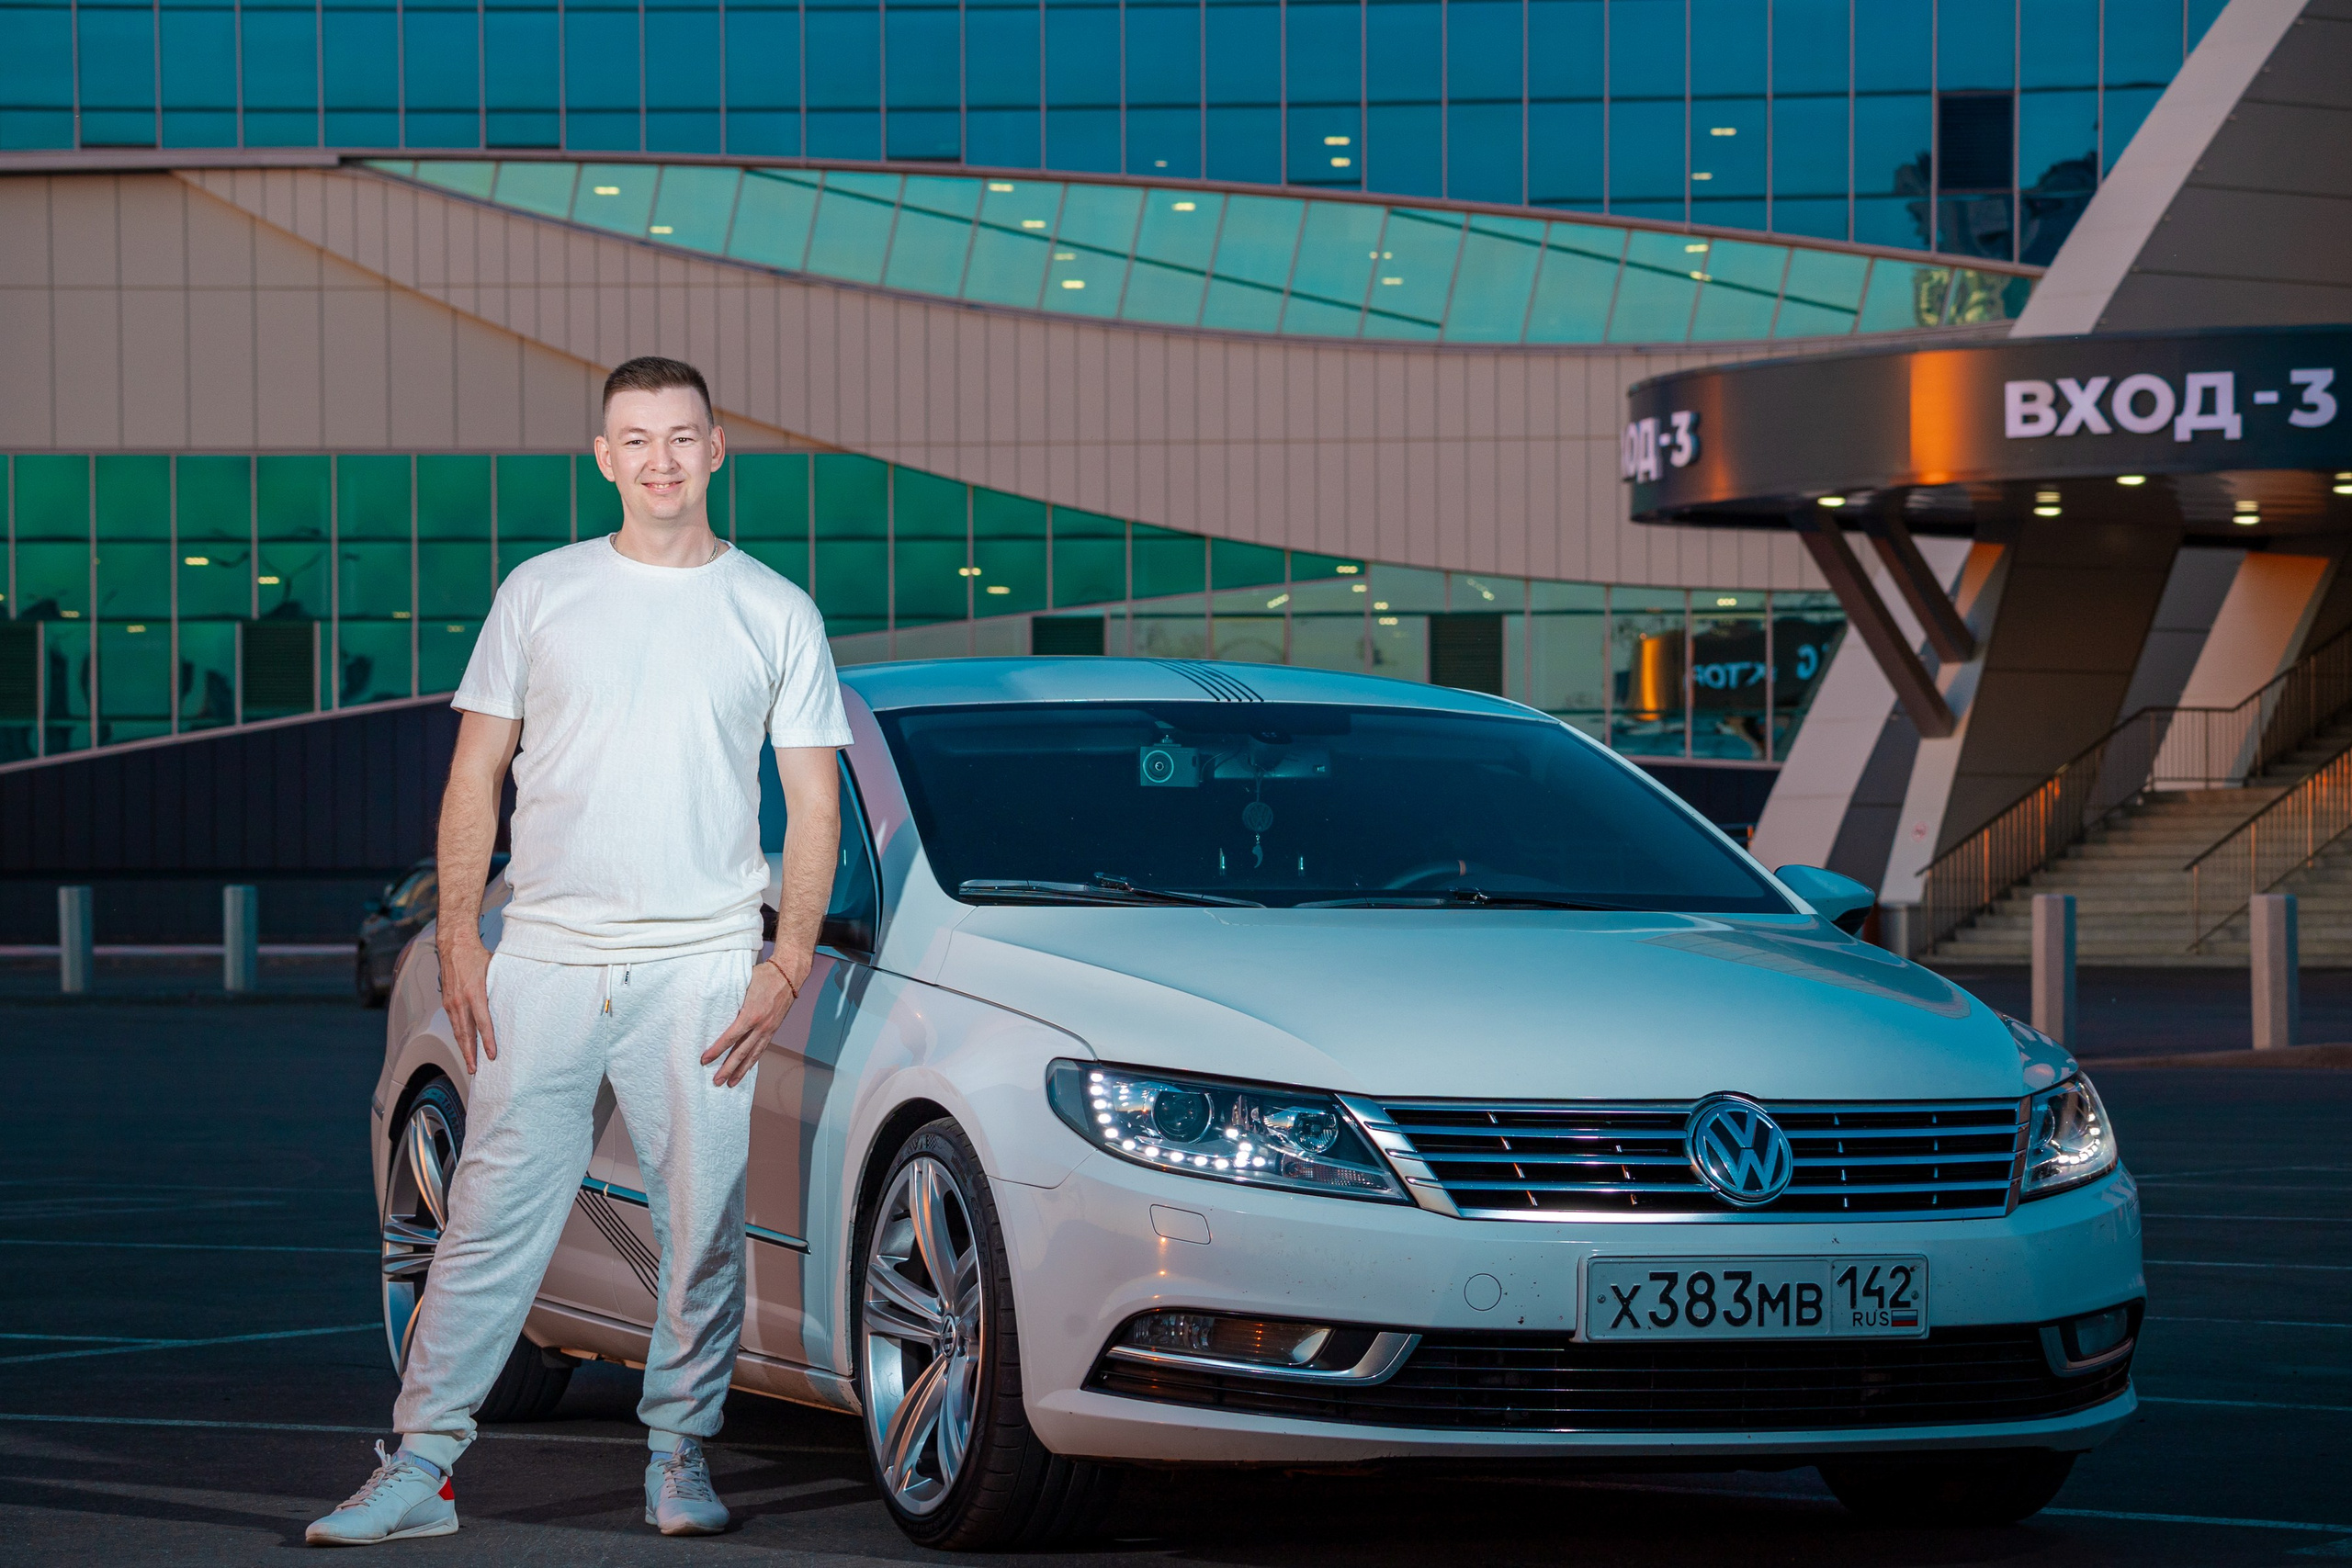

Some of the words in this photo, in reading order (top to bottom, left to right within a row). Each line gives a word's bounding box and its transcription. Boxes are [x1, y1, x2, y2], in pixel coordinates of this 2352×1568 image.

[1692, 1097, 1791, 1202] VW
[1610, 1269, 1823, 1329] Х383МВ
[1836, 1264, 1913, 1309] 142
[1852, 1310, 1889, 1327] RUS
